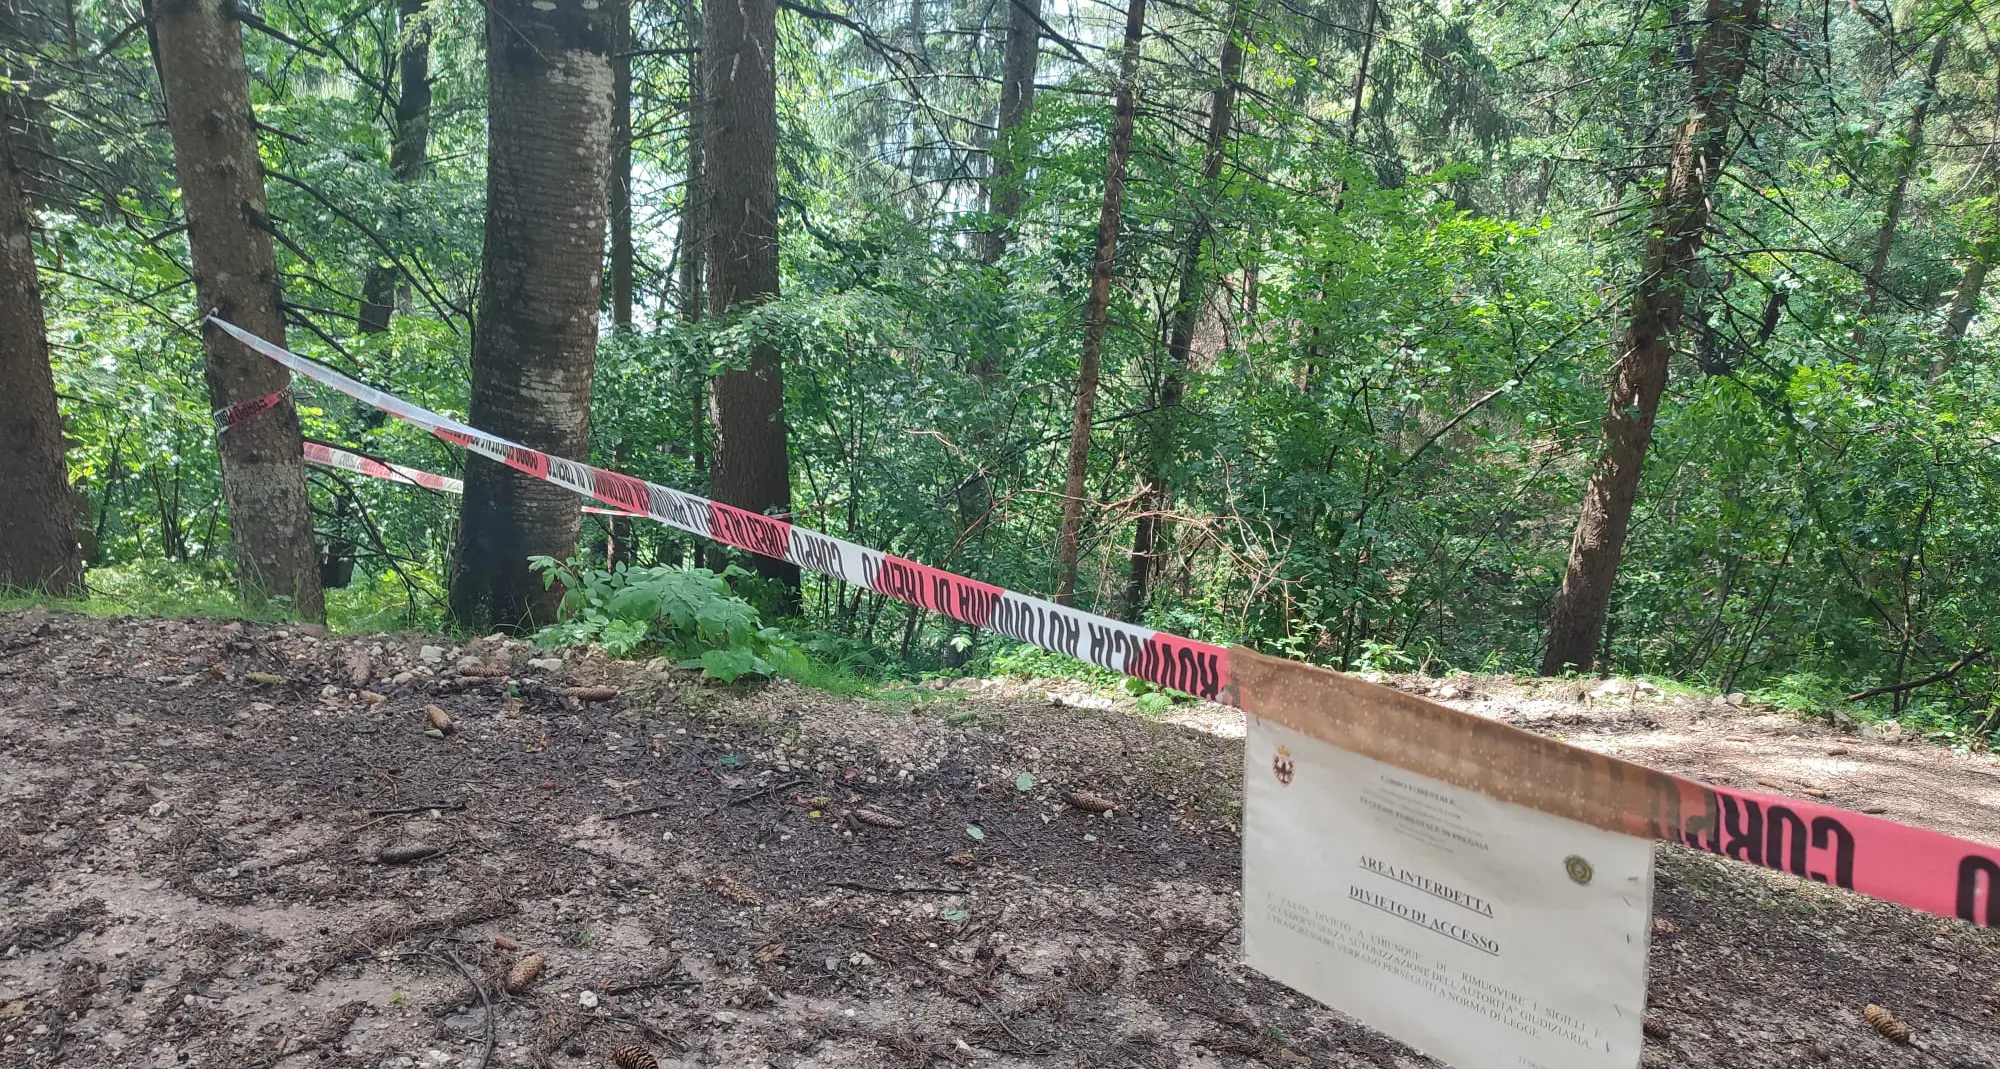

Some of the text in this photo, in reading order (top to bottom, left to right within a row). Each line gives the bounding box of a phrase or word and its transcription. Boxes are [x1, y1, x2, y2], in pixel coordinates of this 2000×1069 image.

[788, 529, 848, 580] CORPO
[862, 552, 929, 609] TRENTO
[932, 575, 958, 619] DI
[957, 583, 1080, 659] AUTONOMA
[1359, 855, 1494, 916] AREA INTERDETTA
[1350, 885, 1499, 953] DIVIETO DI ACCESSO
[1315, 911, 1352, 932] DIVIETO
[1358, 930, 1365, 938] A
[1371, 935, 1422, 961] CHIUNQUE
[1436, 961, 1447, 973] DI
[1462, 971, 1525, 1006] RIMUOVERE
[1545, 1007, 1586, 1032] SIGILLI
[1439, 988, 1446, 998] A
[1448, 991, 1487, 1015] NORMA
[1490, 1009, 1501, 1022] DI
